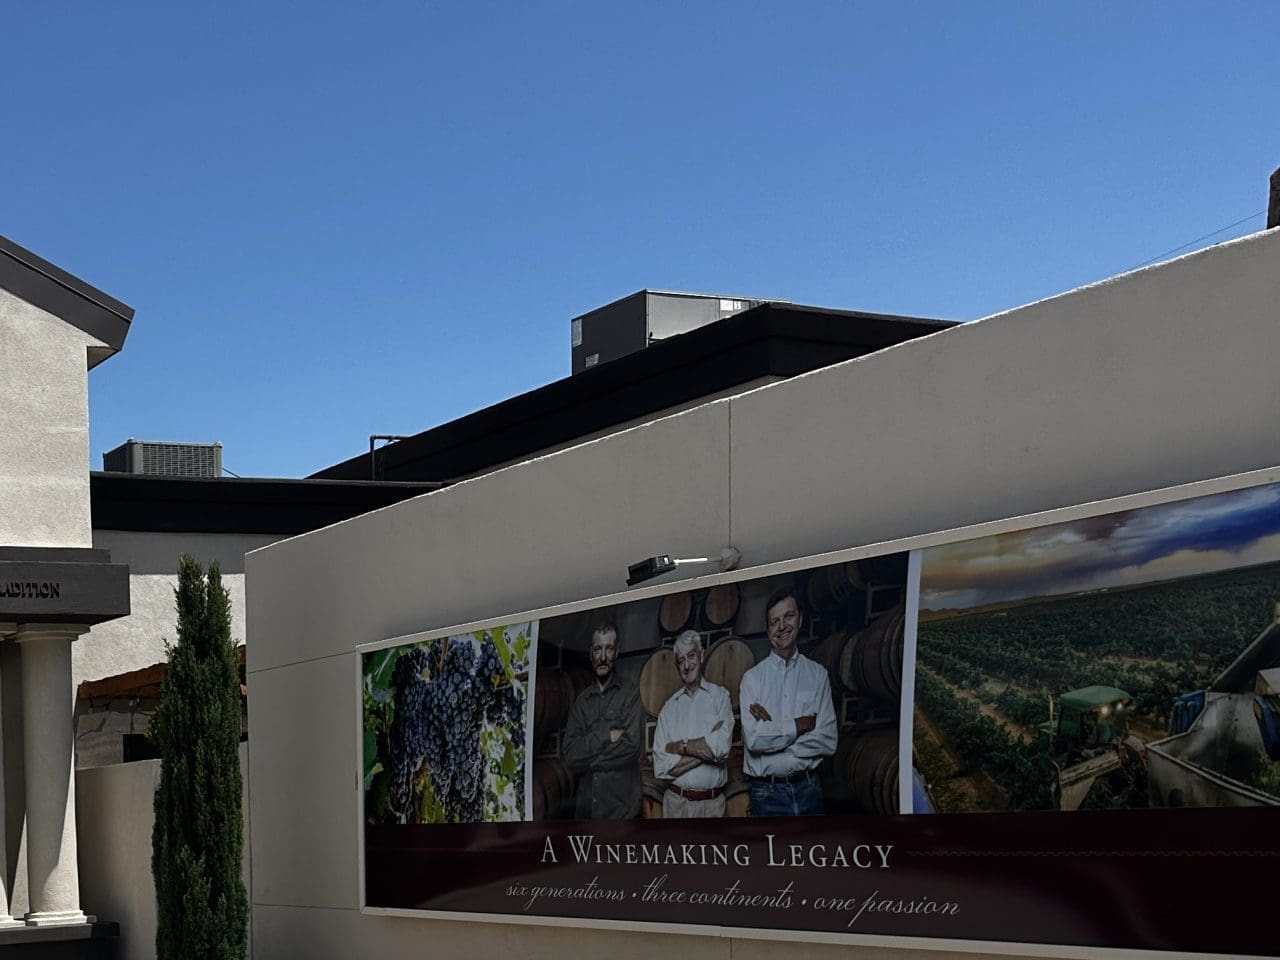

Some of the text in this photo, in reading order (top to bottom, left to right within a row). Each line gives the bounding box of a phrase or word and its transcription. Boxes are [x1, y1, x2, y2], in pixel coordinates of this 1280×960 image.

[540, 834, 895, 868] A WINEMAKING LEGACY
[506, 873, 961, 928] six generations three continents one passion
